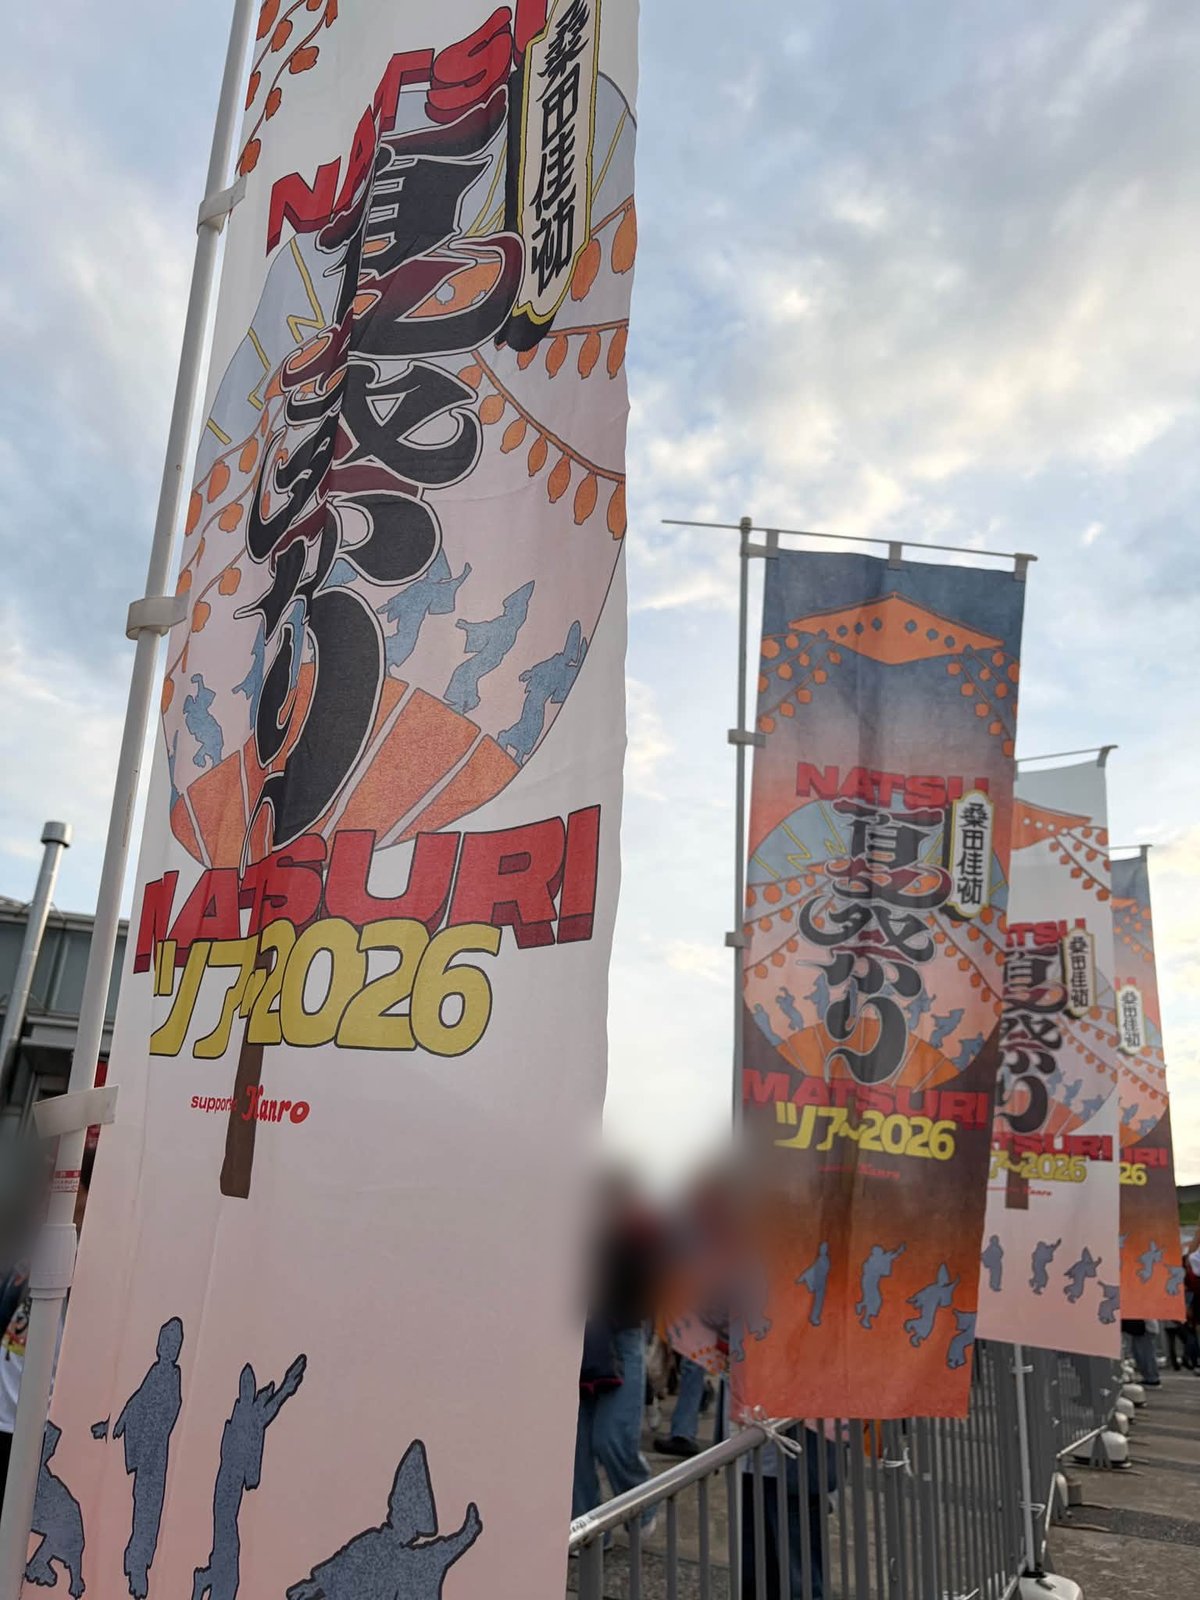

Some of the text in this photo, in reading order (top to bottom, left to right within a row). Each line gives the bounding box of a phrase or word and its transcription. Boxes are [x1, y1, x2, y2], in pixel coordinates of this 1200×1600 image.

[957, 802, 989, 905] 桑田佳祐
[742, 1067, 989, 1132] MATSURI
